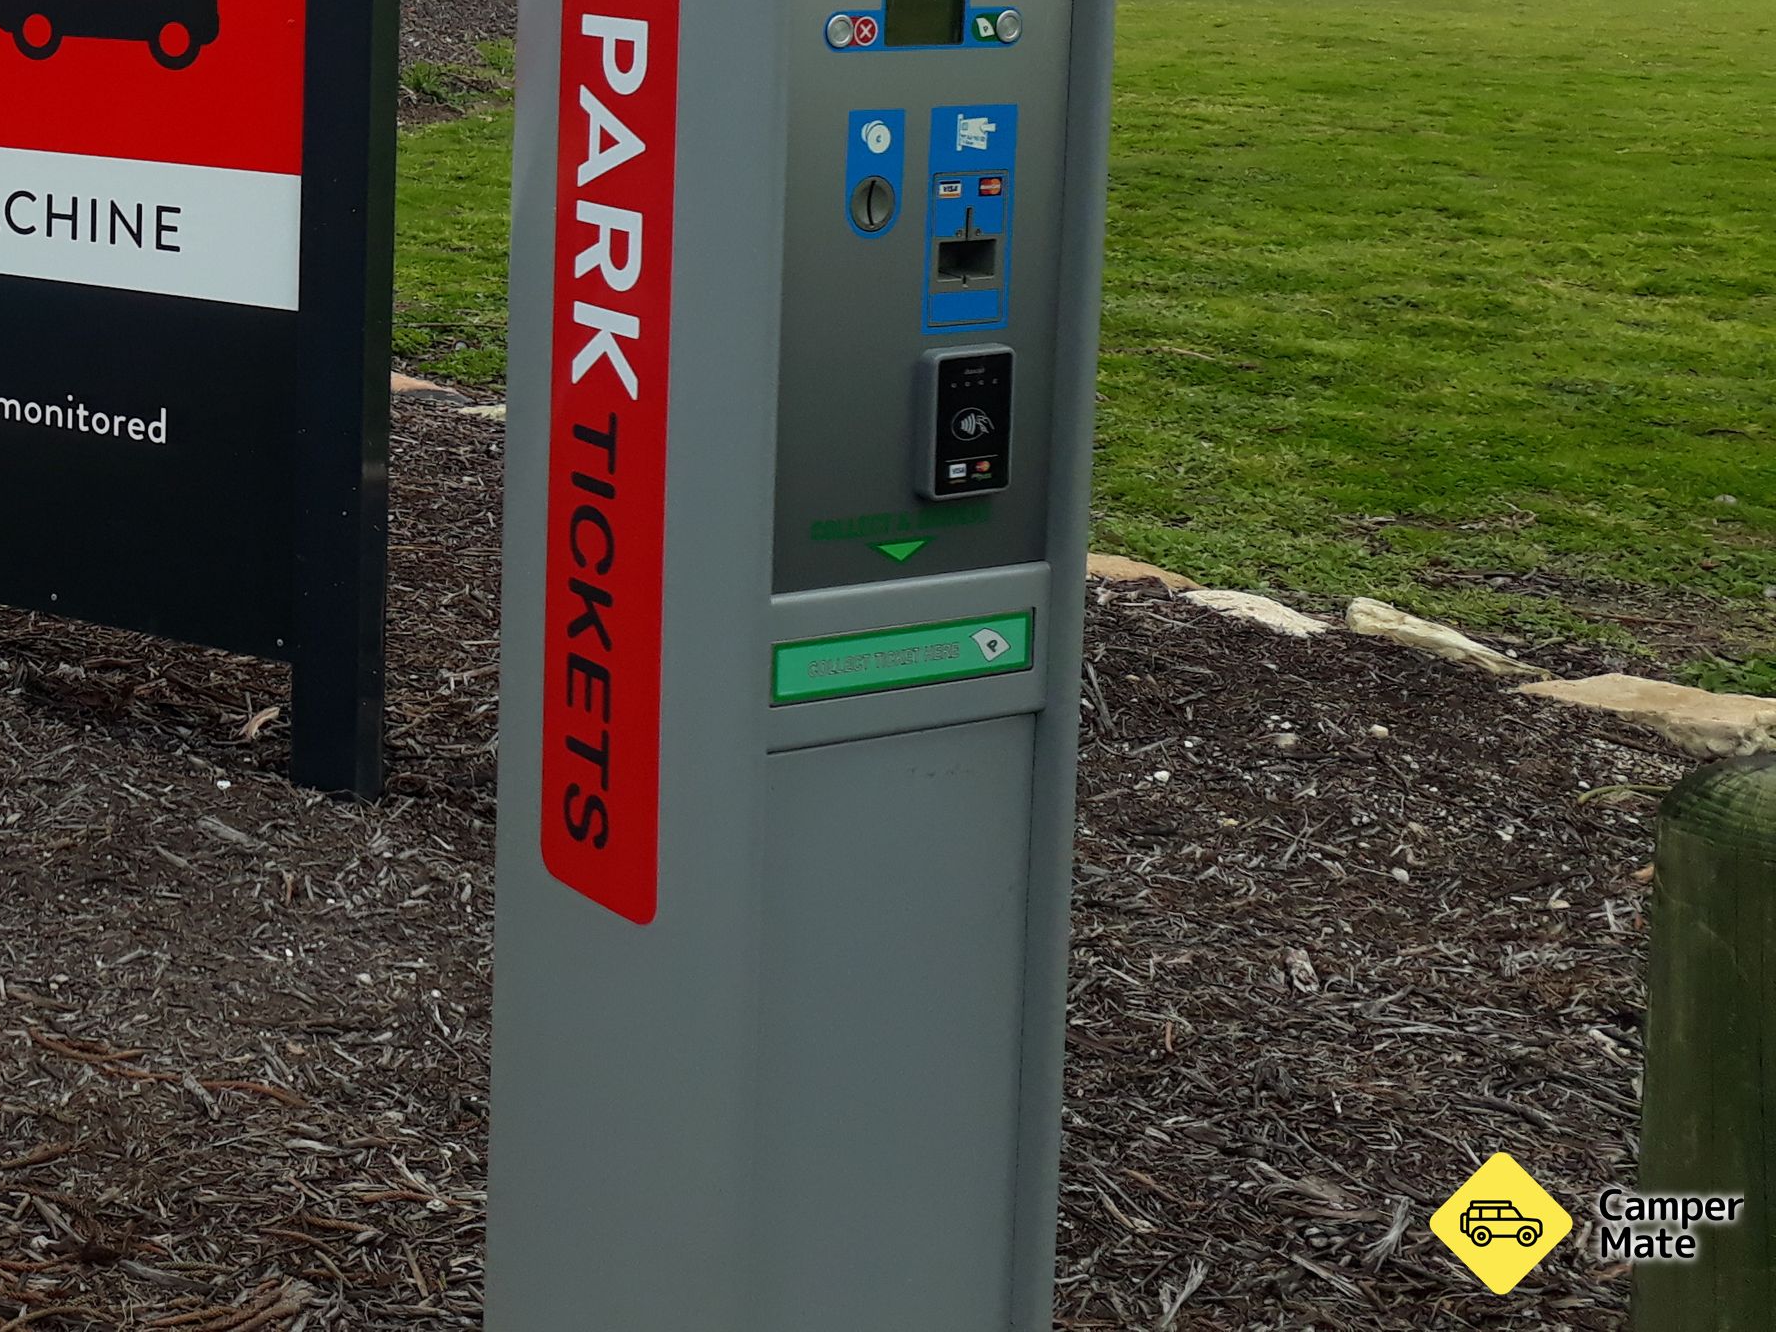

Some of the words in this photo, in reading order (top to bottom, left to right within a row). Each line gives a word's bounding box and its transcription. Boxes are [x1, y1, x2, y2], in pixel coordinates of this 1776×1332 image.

[572, 13, 649, 401] PARK
[563, 411, 618, 851] TICKETS
[808, 653, 871, 678] COLLECT
[873, 646, 920, 669] TICKET
[924, 641, 961, 662] HERE
[986, 639, 999, 653] P
